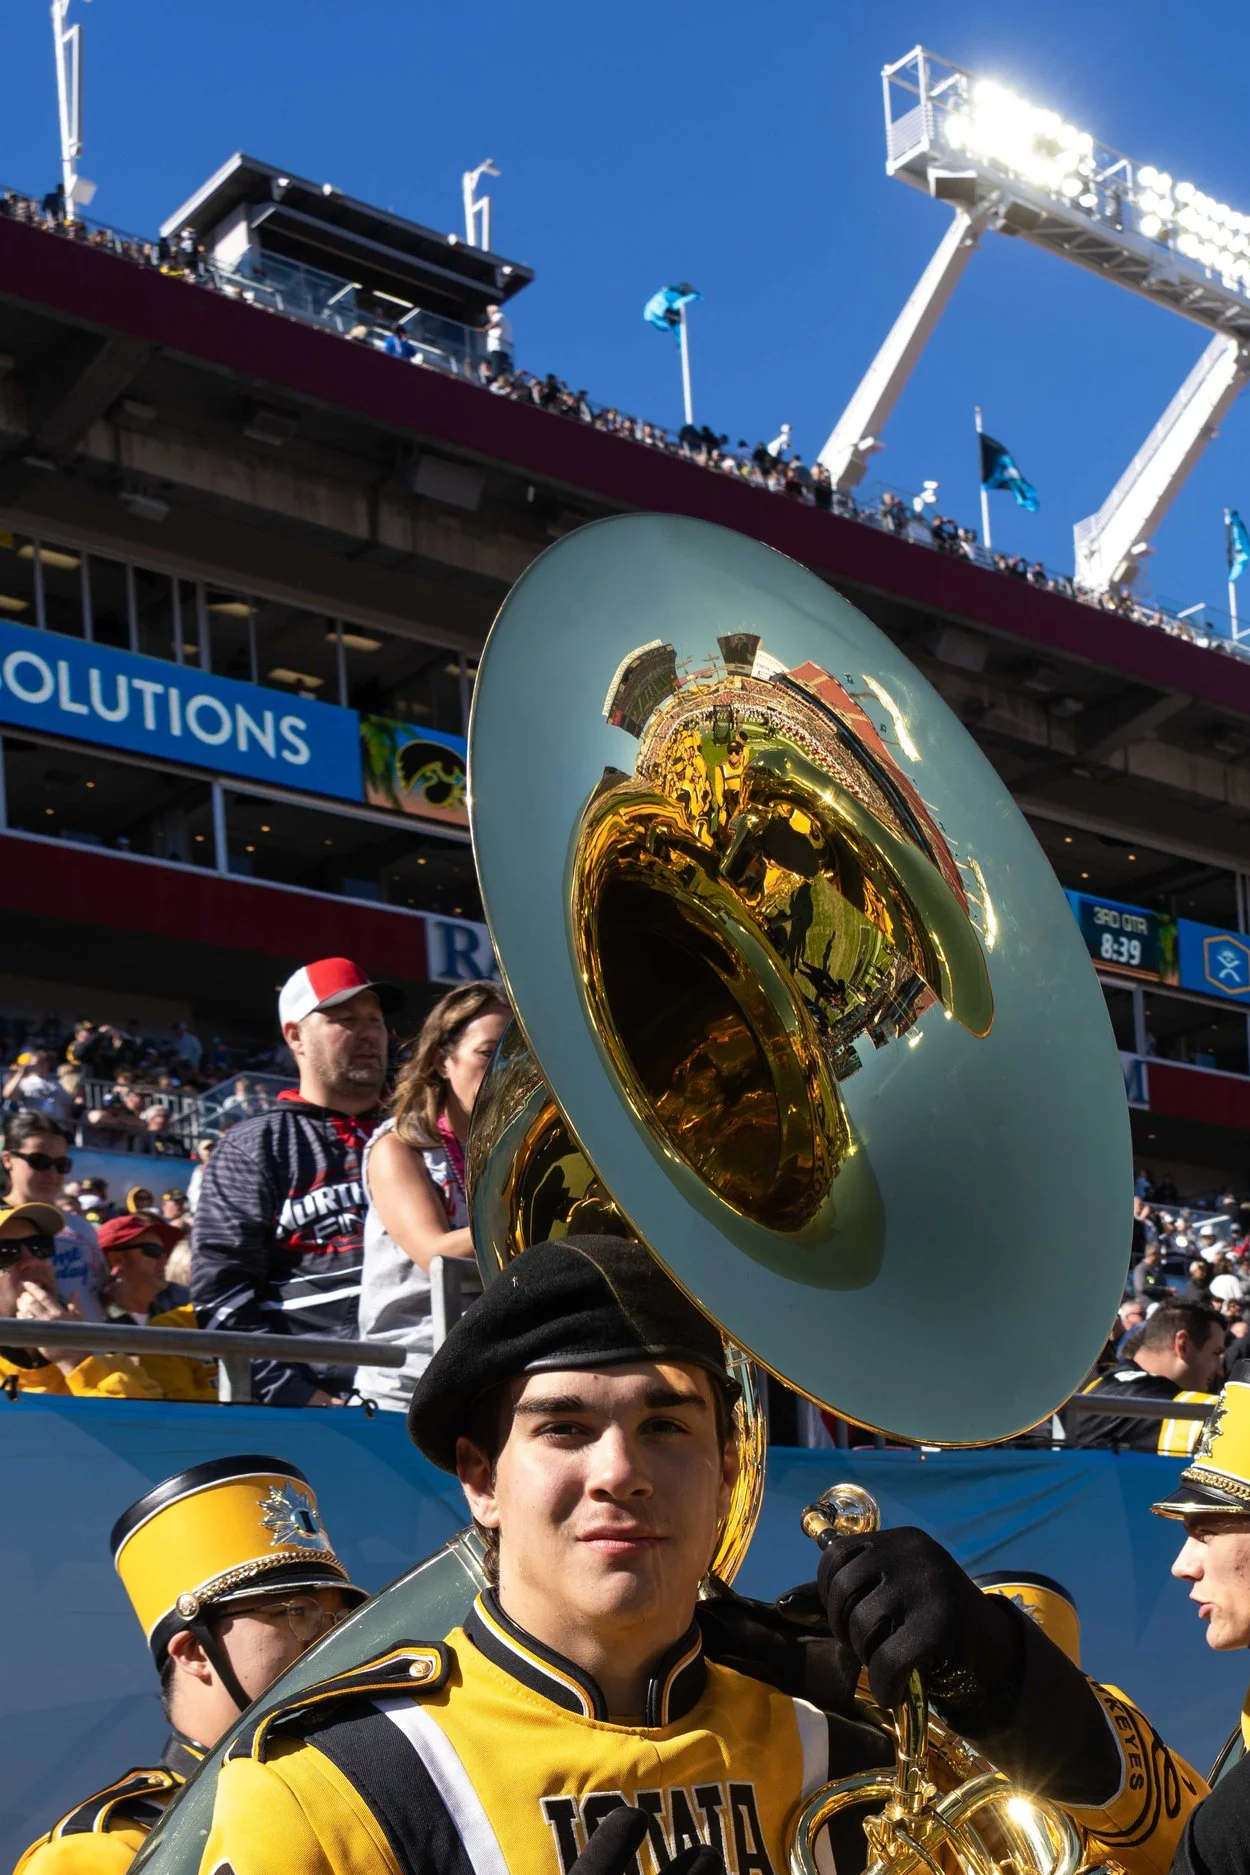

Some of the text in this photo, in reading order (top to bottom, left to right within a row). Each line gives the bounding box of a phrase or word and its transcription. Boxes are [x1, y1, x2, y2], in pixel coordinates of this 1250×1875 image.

[0, 651, 311, 765] OLUTIONS
[1101, 932, 1141, 965] 8:39
[1098, 1688, 1145, 1790] KEYES
